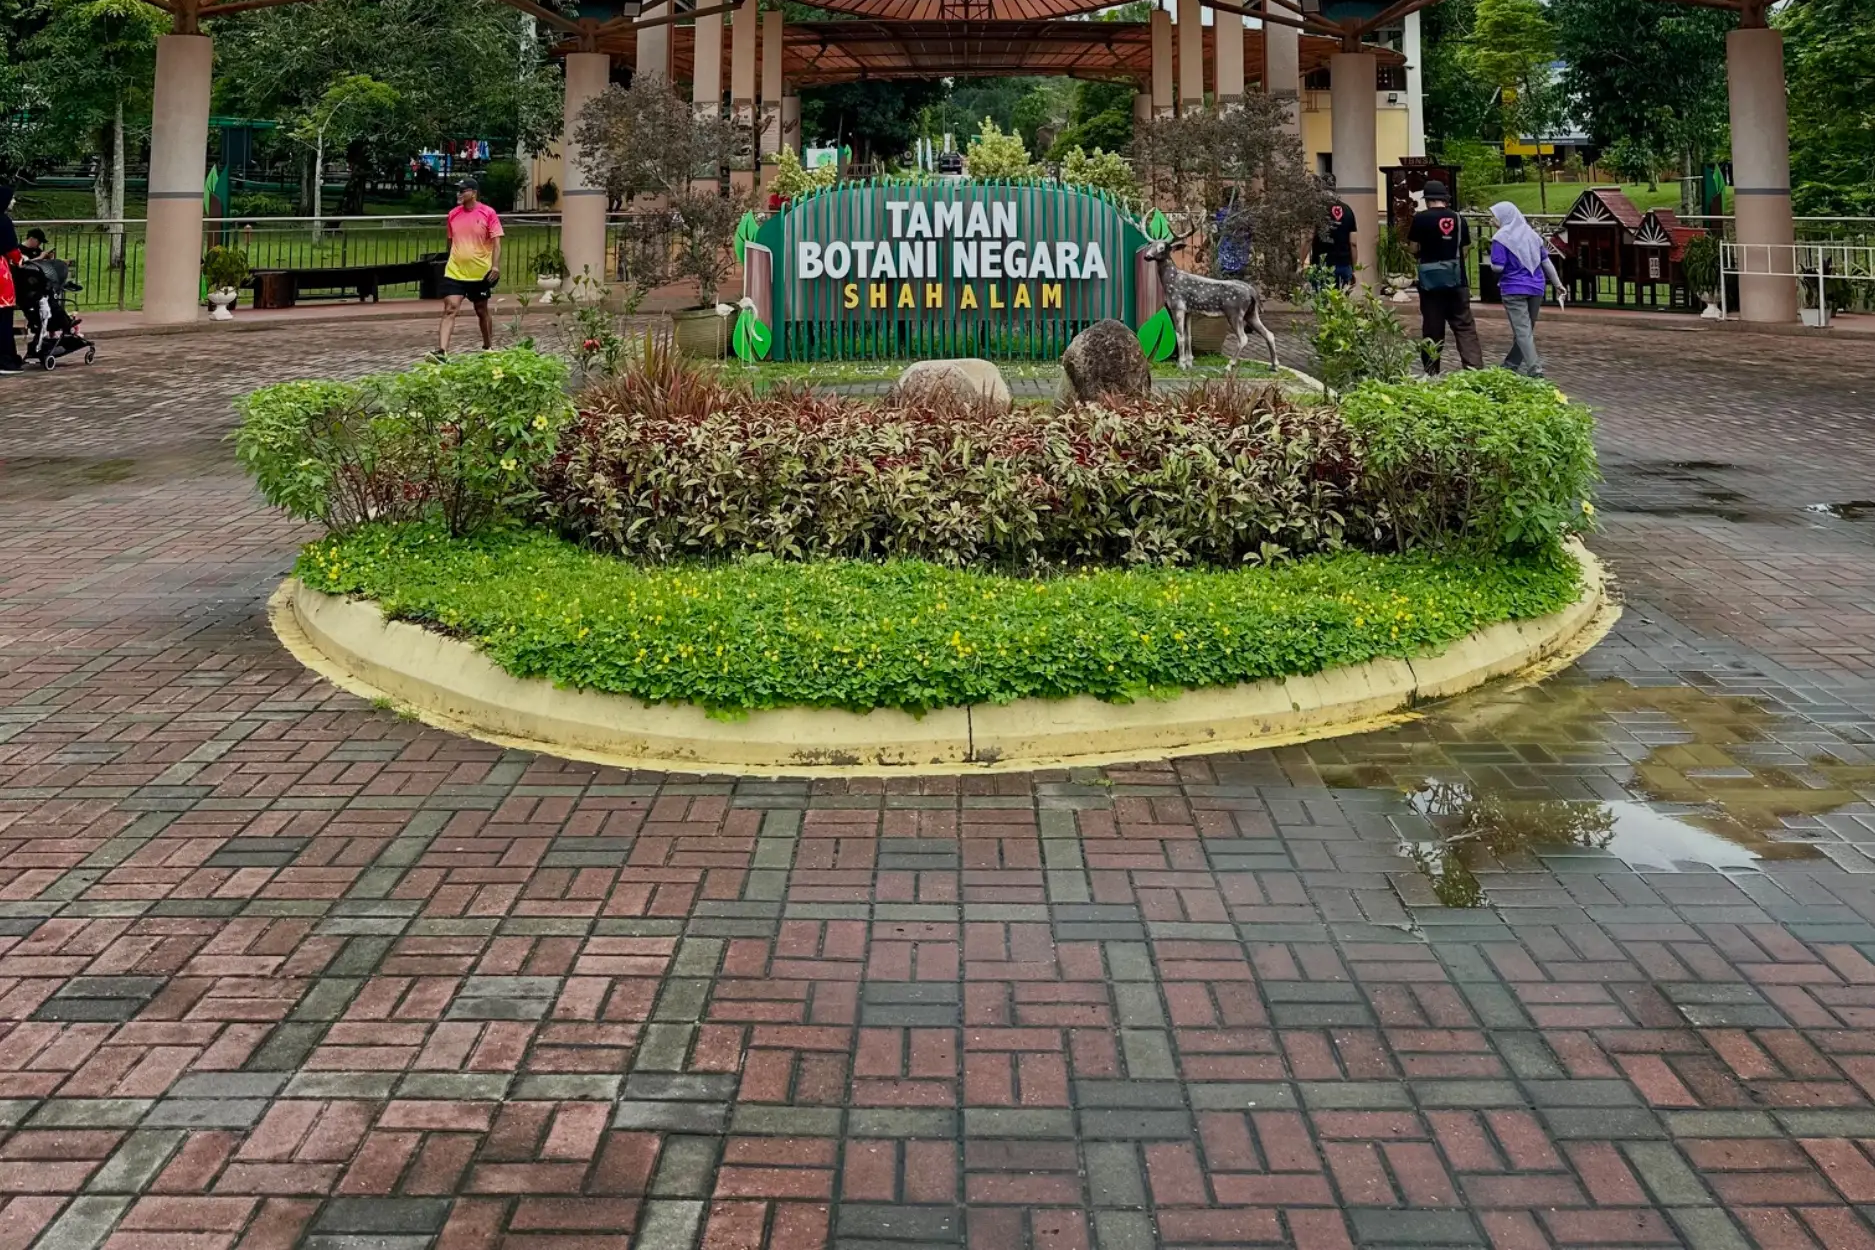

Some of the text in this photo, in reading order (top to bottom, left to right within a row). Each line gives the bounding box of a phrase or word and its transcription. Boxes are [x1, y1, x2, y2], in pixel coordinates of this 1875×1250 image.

[886, 201, 1017, 238] TAMAN
[799, 242, 1108, 279] BOTANI NEGARA
[844, 283, 1063, 309] SHAH ALAM
